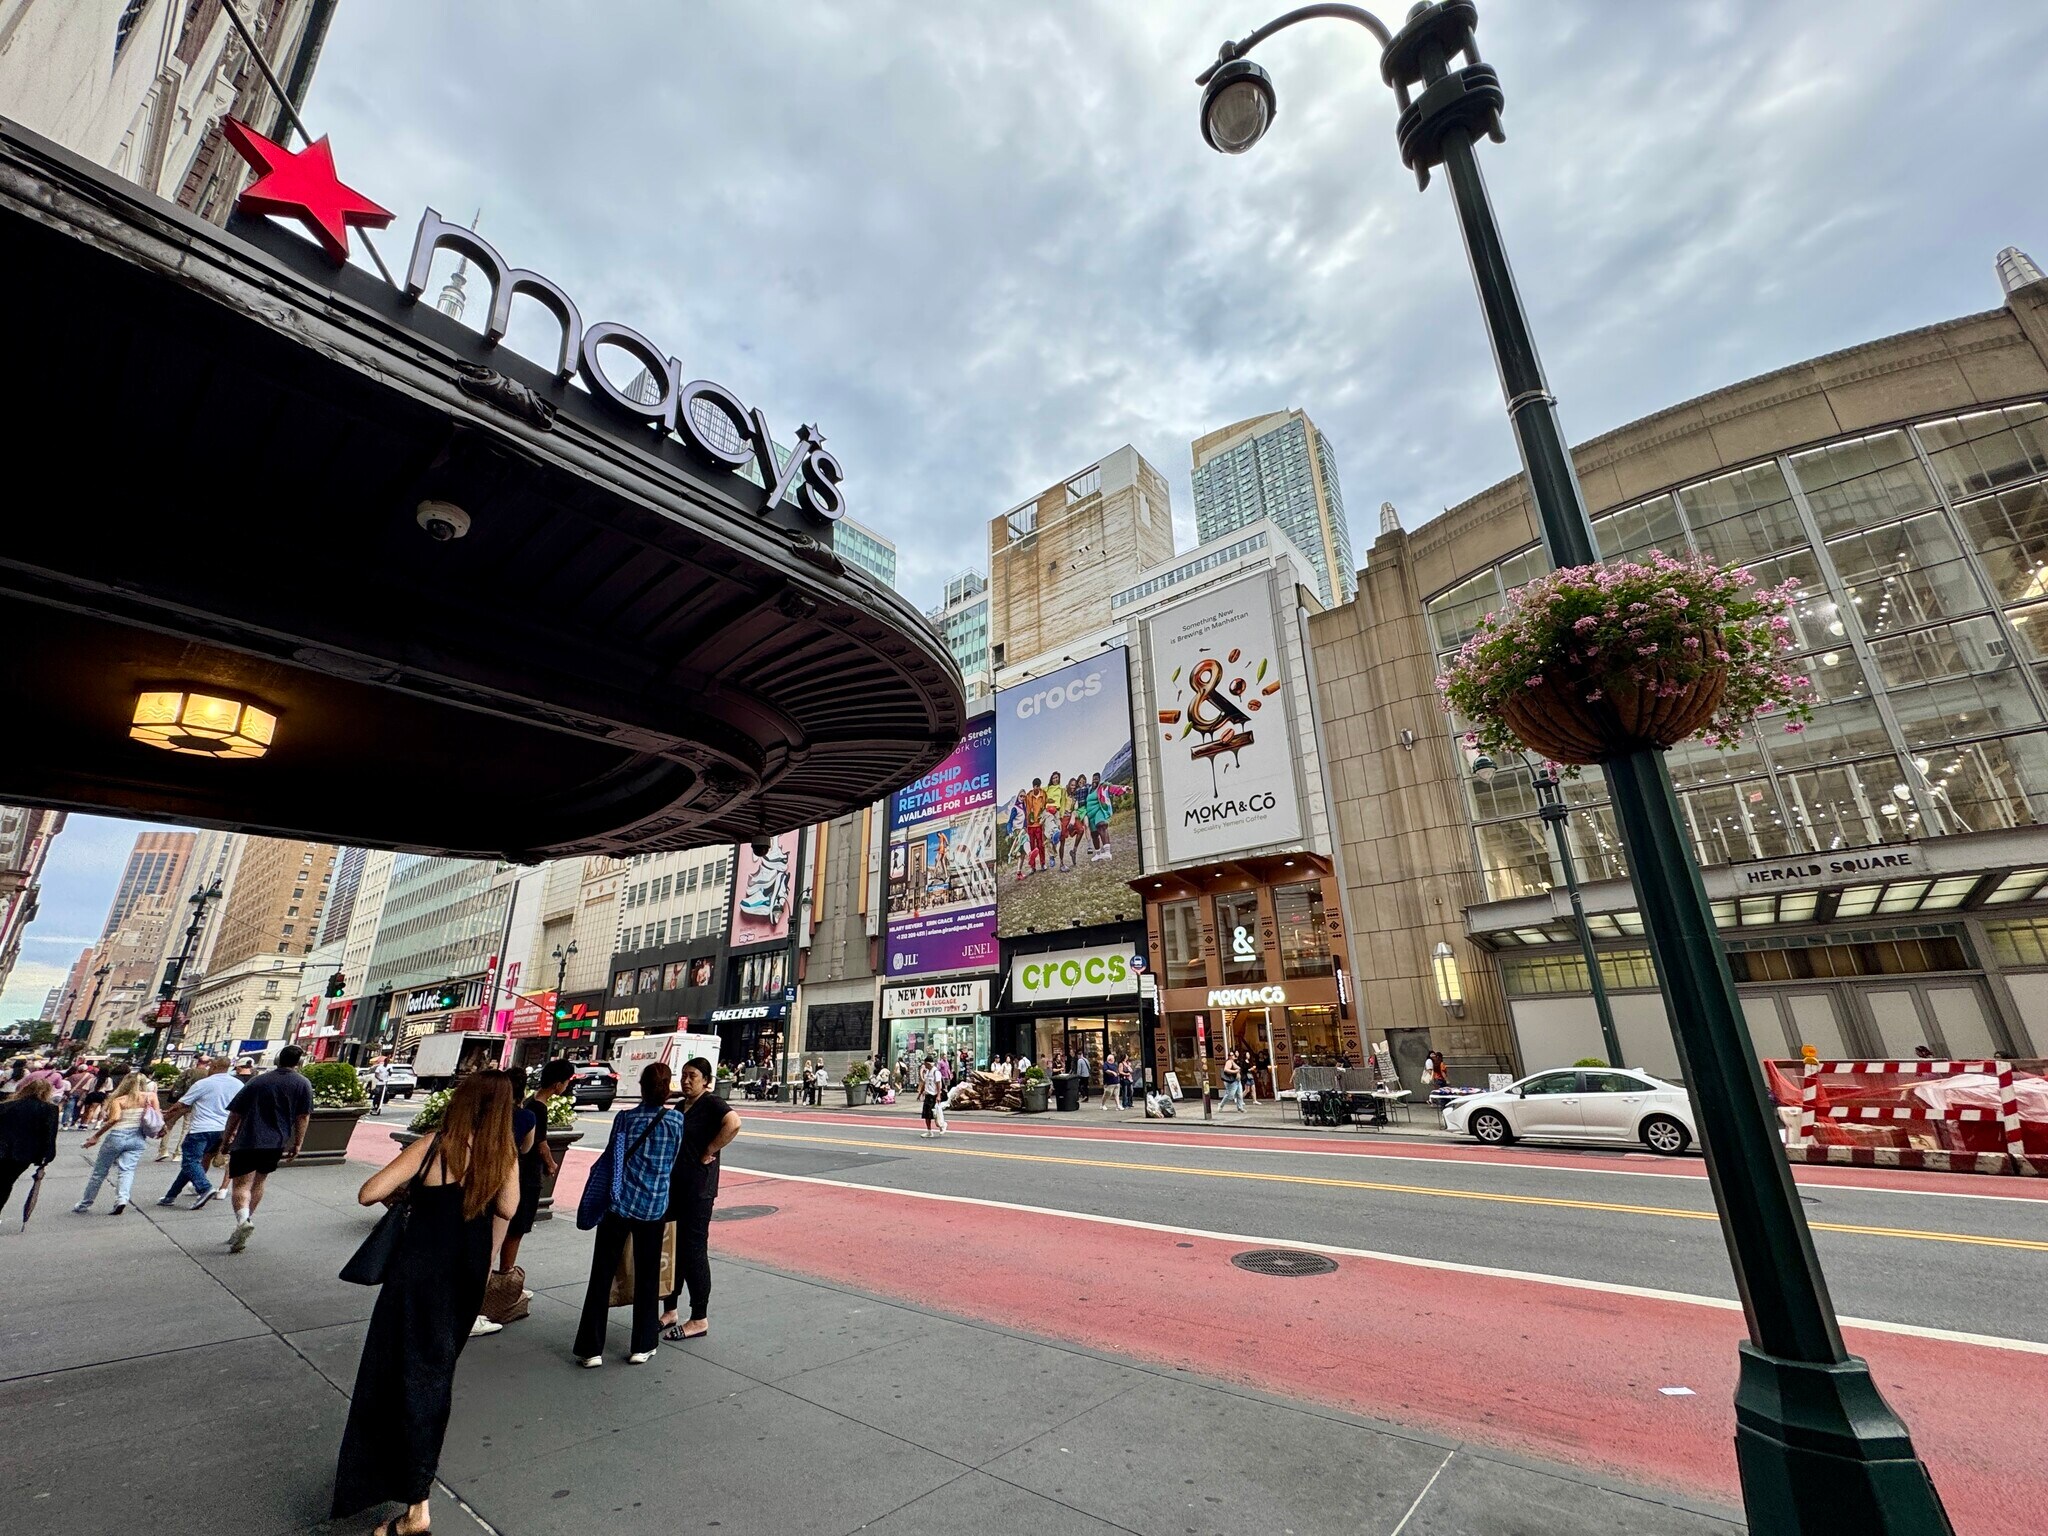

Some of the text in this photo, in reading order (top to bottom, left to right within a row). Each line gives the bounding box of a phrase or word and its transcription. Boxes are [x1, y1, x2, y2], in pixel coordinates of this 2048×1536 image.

[1177, 629, 1203, 642] Brewing
[1211, 612, 1249, 630] Manhattan
[1182, 608, 1234, 631] Something New
[1017, 673, 1102, 719] crocs
[967, 726, 992, 741] Street
[952, 744, 970, 756] ork
[973, 736, 992, 748] City
[899, 765, 961, 796] FLAGSHIP
[898, 773, 990, 812] RETAIL SPACE
[898, 789, 993, 824] AVAILABLE FOR LEASE
[1222, 819, 1245, 828] Yemeni
[1245, 814, 1267, 823] Coffee
[1747, 853, 1913, 884] HERALD SQUARE
[957, 914, 976, 922] ARIANE
[976, 910, 995, 919] GIRARD
[962, 942, 993, 957] JENEL
[1022, 955, 1126, 990] crocs
[898, 988, 917, 1001] NEW
[950, 984, 972, 998] CITY
[932, 998, 956, 1006] LUGGAGE
[604, 1007, 640, 1026] HOLLISTER
[711, 1006, 770, 1022] SKECHERS
[406, 1022, 435, 1037] SEPHORA
